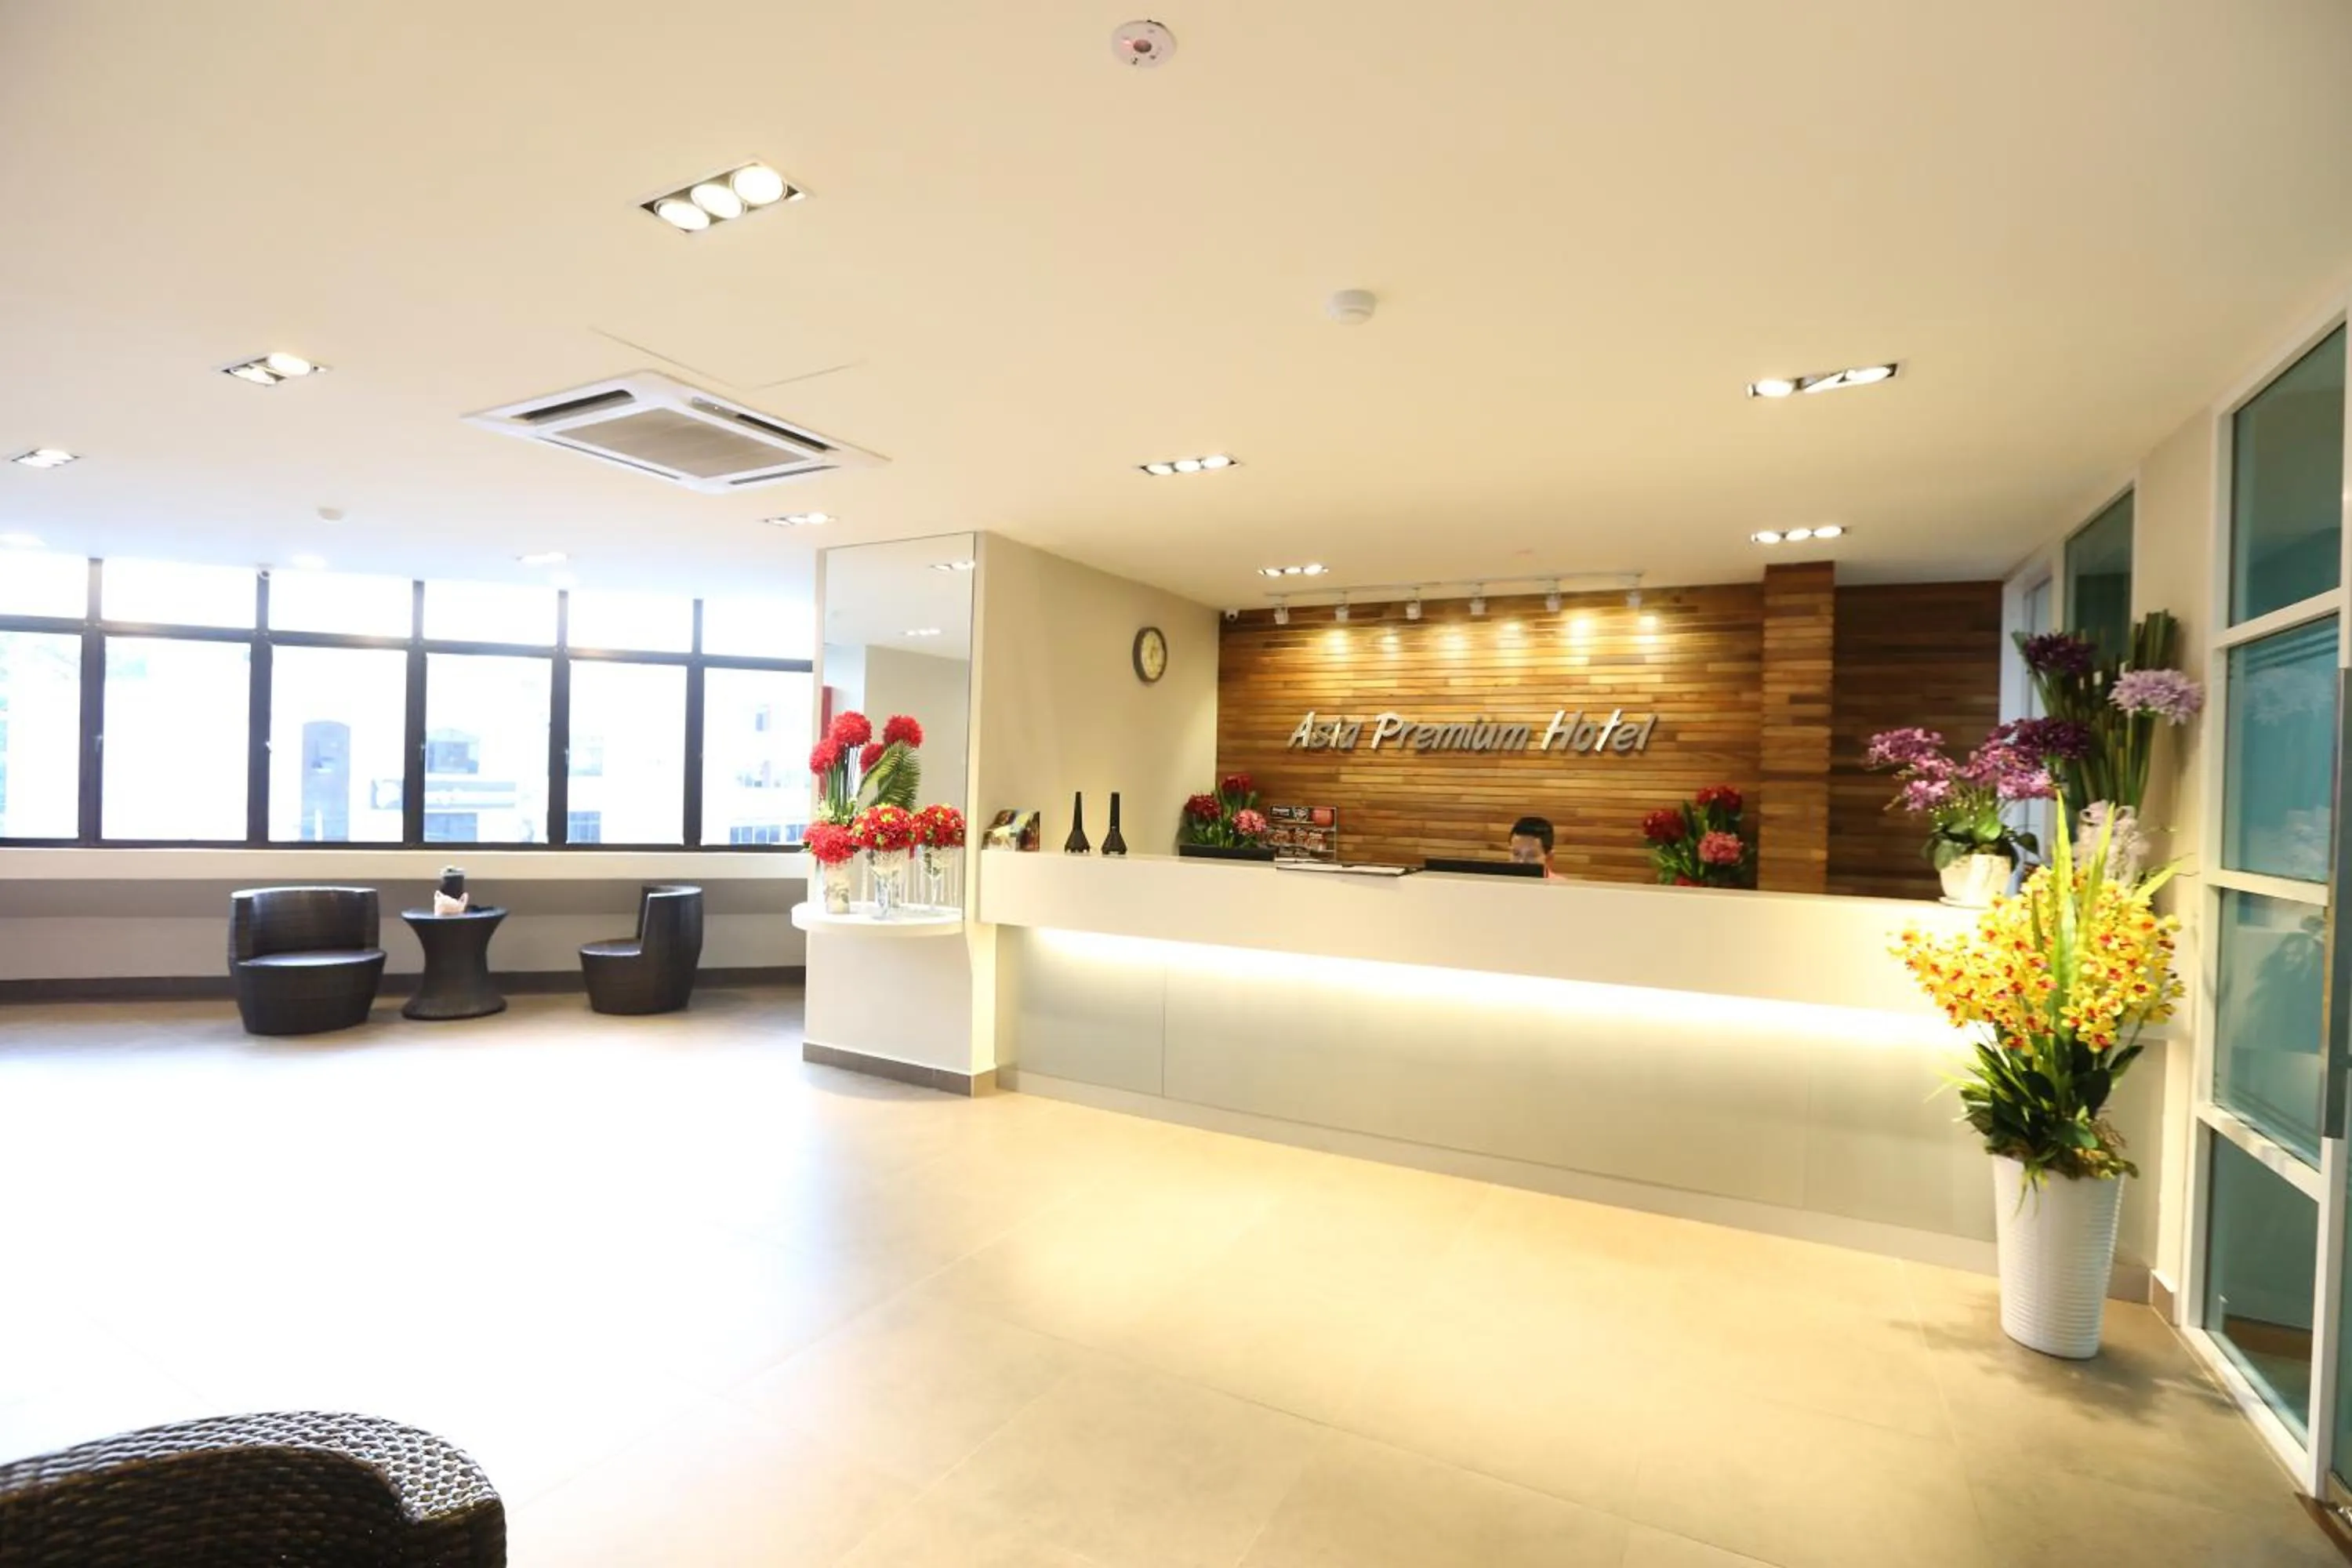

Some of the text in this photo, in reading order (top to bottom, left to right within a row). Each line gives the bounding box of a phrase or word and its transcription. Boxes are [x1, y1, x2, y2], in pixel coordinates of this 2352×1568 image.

[1289, 708, 1657, 753] Asia Premium Hotel
